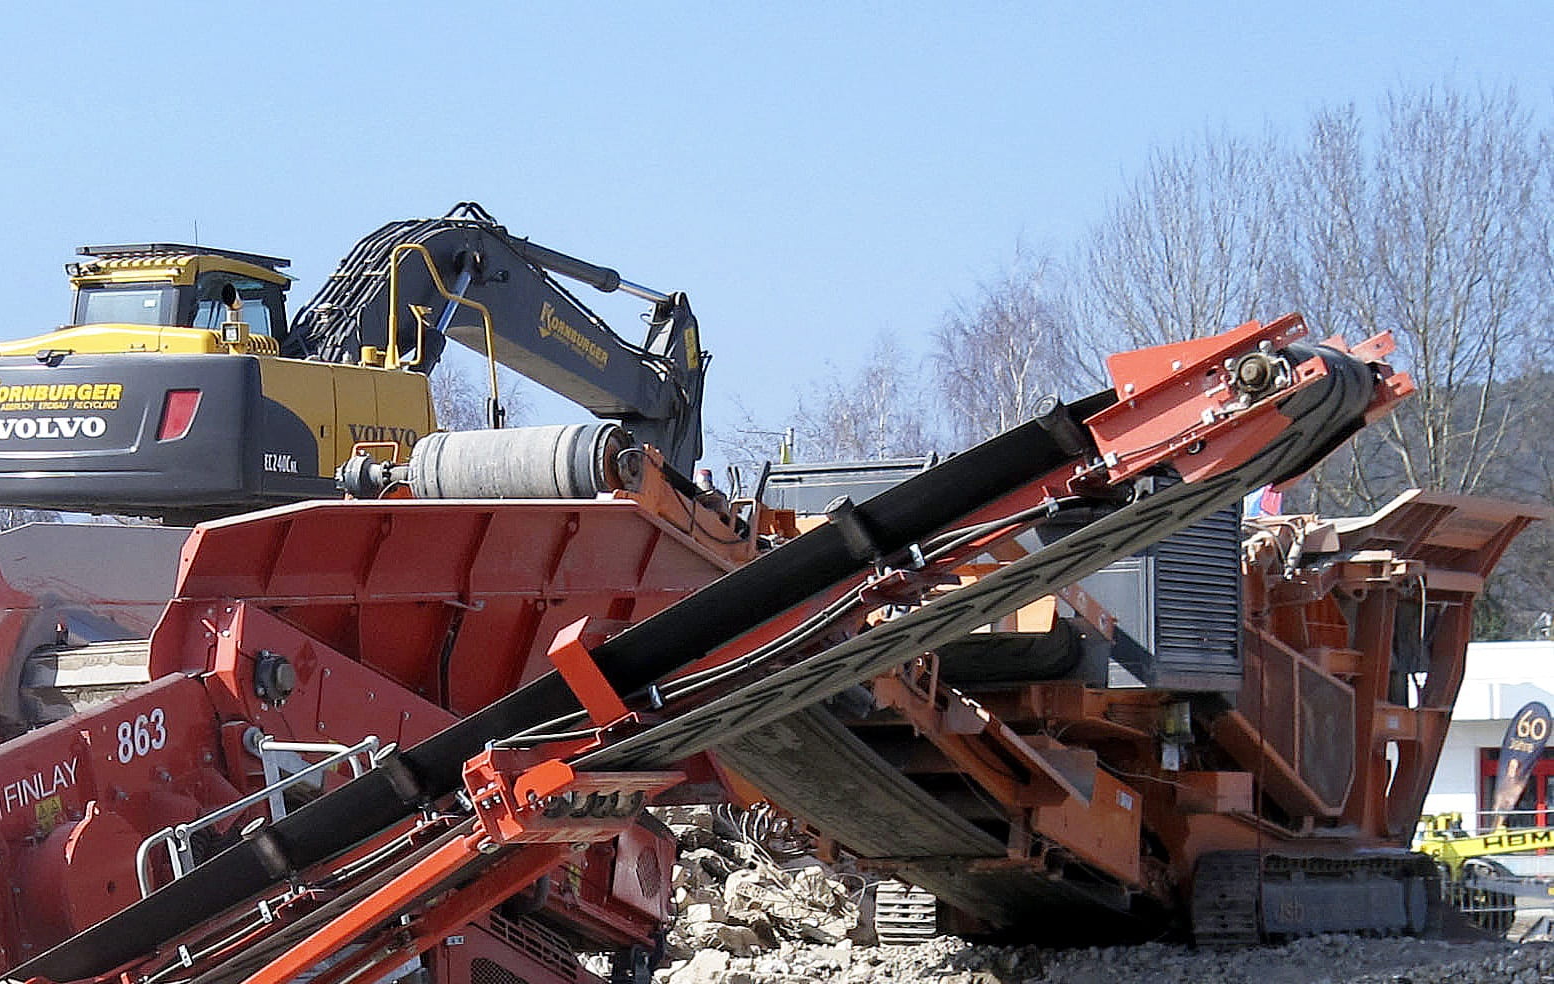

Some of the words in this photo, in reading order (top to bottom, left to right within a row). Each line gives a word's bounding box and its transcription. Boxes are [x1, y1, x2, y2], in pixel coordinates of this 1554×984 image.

[73, 400, 118, 410] RECYCLING
[349, 423, 417, 448] VOLVO
[116, 707, 167, 765] 863
[1516, 709, 1547, 741] 60
[3, 757, 79, 814] FINLAY
